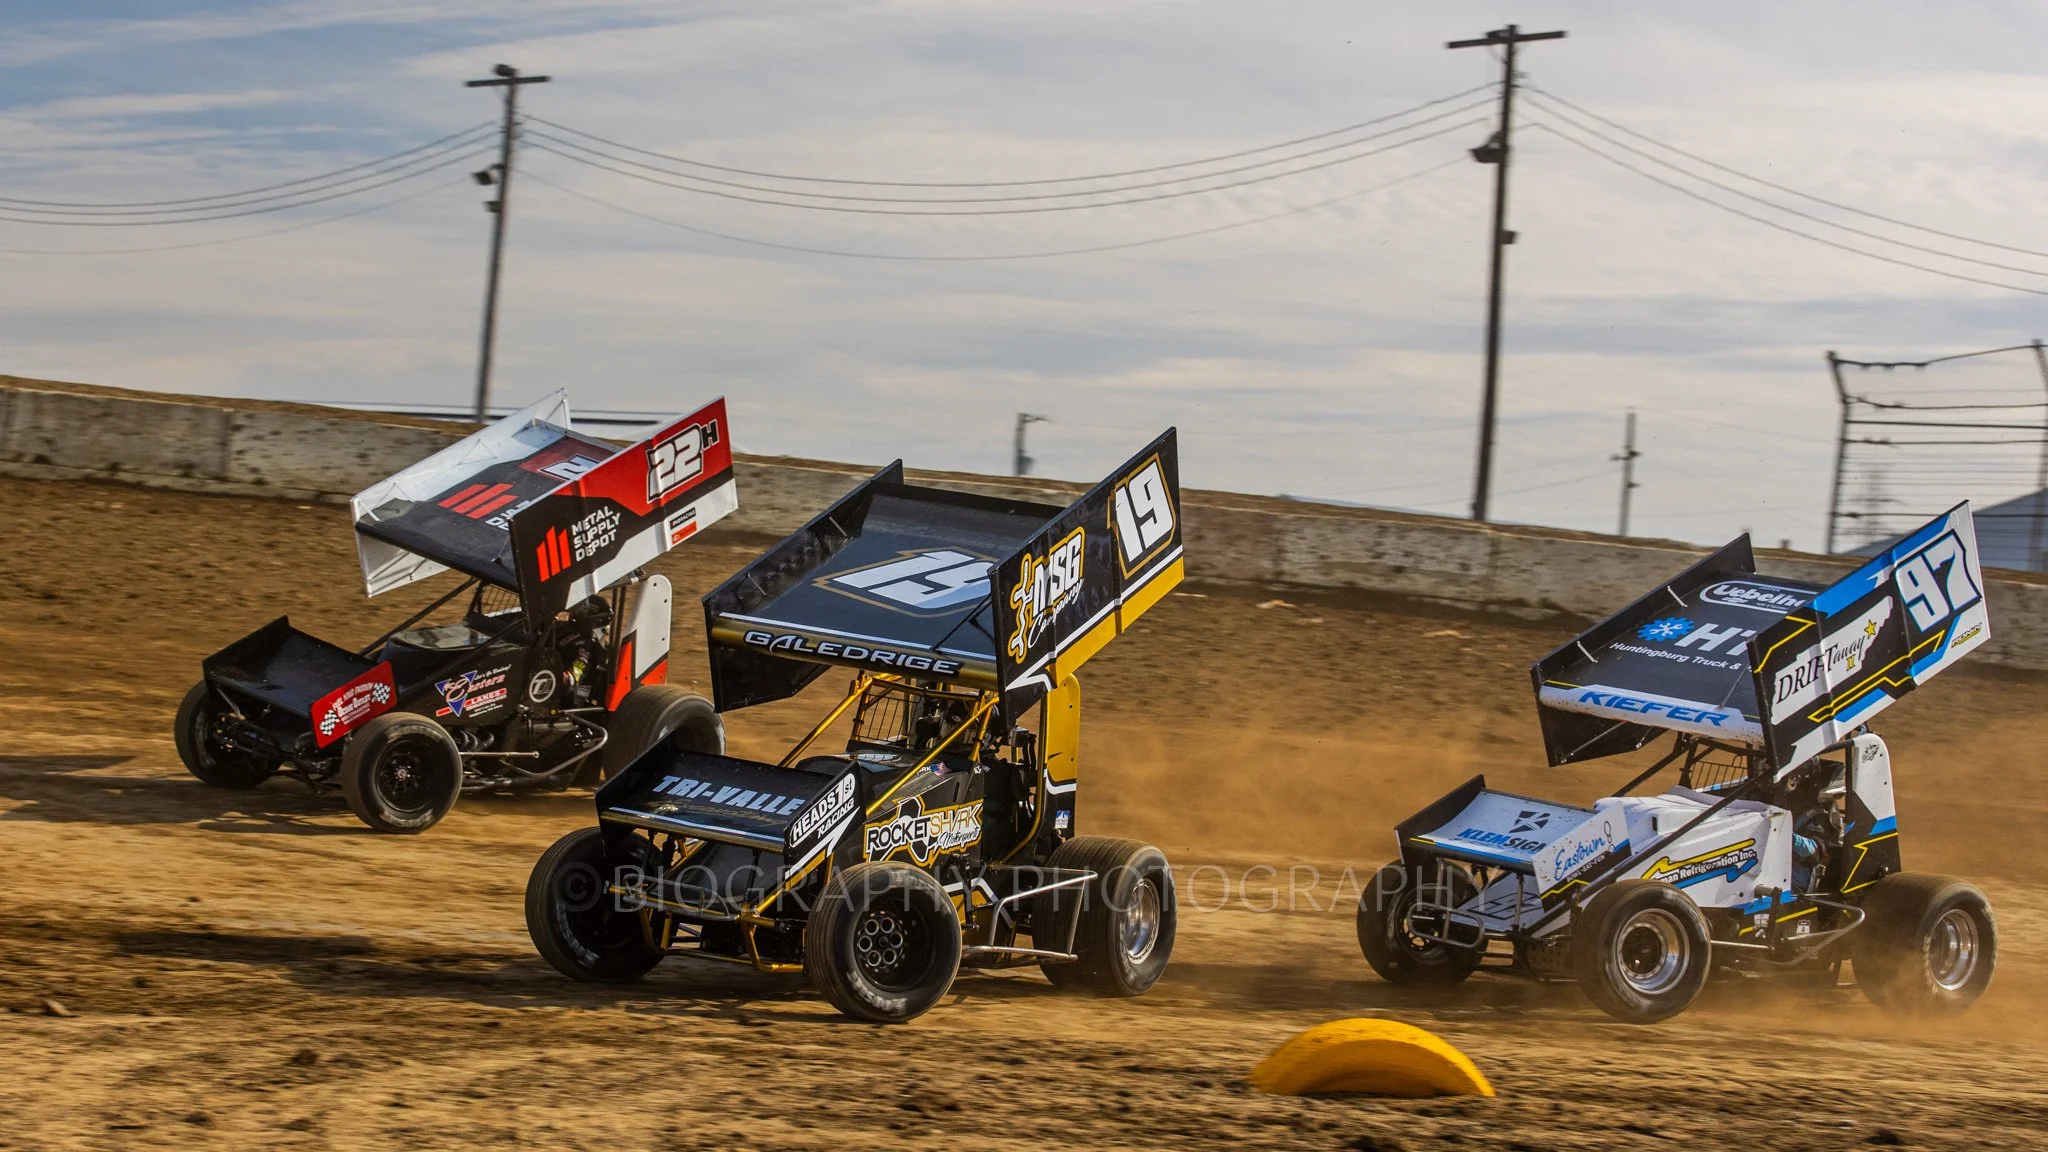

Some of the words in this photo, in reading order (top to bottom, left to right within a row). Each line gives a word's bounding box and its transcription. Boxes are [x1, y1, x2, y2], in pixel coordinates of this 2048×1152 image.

[571, 505, 614, 536] METAL
[573, 512, 621, 549] SUPPLY
[1115, 461, 1174, 563] 19
[575, 529, 617, 562] DEPOT
[1896, 533, 1982, 632] 97
[745, 631, 959, 675] GALEDRIGE
[1609, 642, 1690, 664] Huntingburg
[1691, 656, 1729, 671] Truck
[1730, 662, 1742, 671] &
[1578, 690, 1730, 727] KIEFER
[817, 797, 855, 839] RACING
[1555, 836, 1606, 882] Eastown
[1659, 873, 1679, 884] man
[1679, 854, 1740, 879] Refrigeration
[1739, 848, 1757, 861] Inc.
